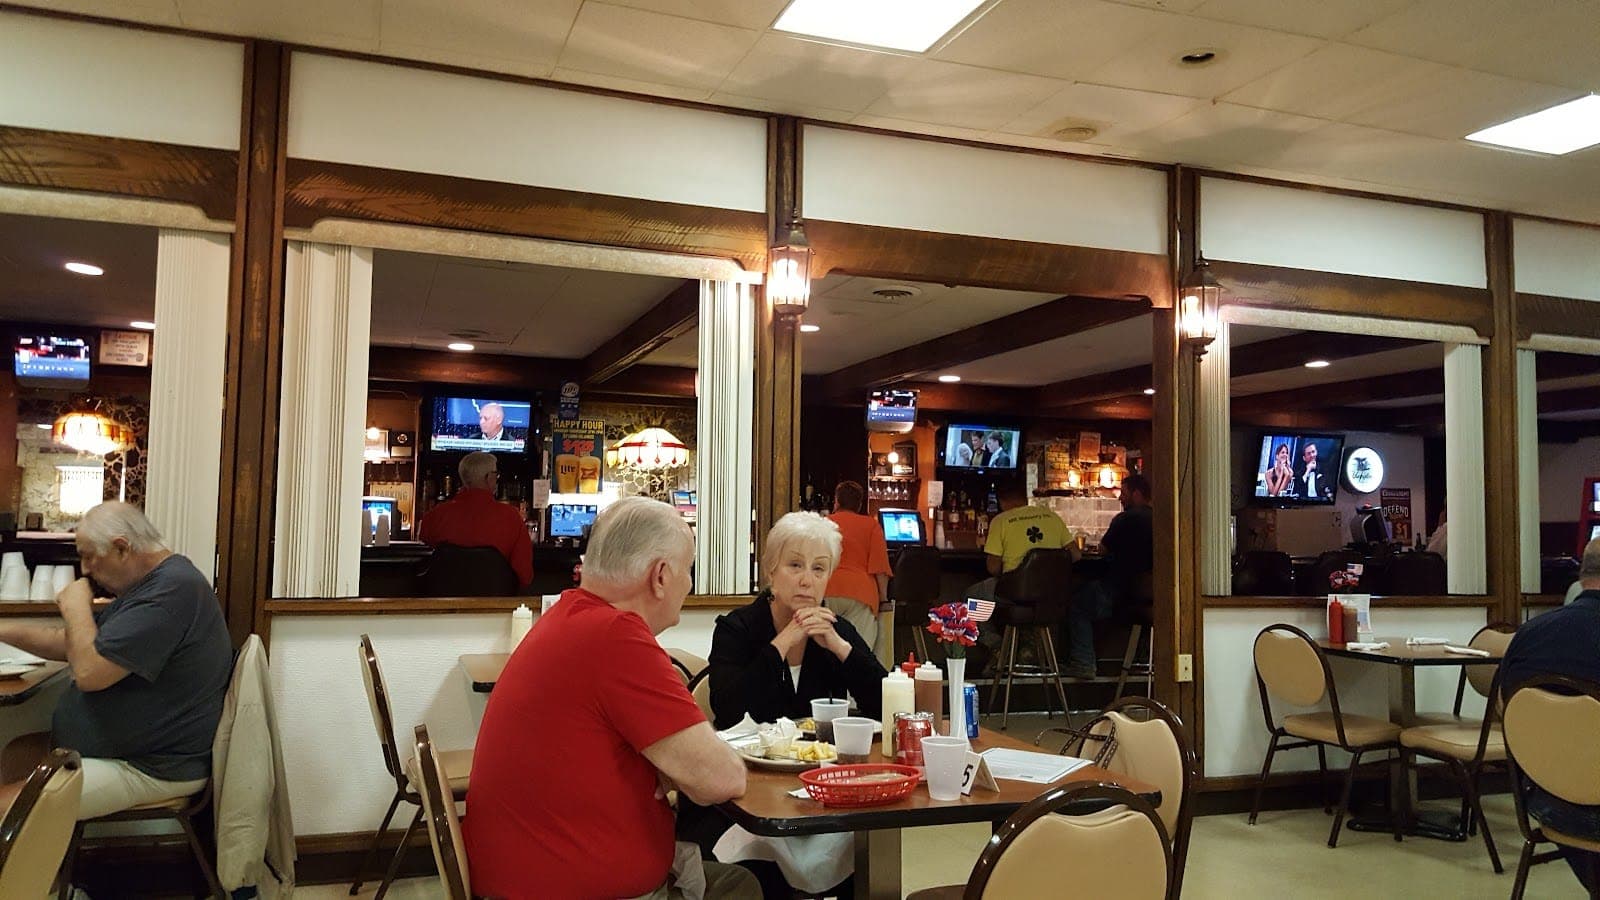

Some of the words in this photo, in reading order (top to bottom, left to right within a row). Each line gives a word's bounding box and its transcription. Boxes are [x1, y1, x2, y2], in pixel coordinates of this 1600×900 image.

[554, 419, 580, 429] HAPPY
[582, 420, 603, 430] HOUR
[962, 764, 974, 787] 5
